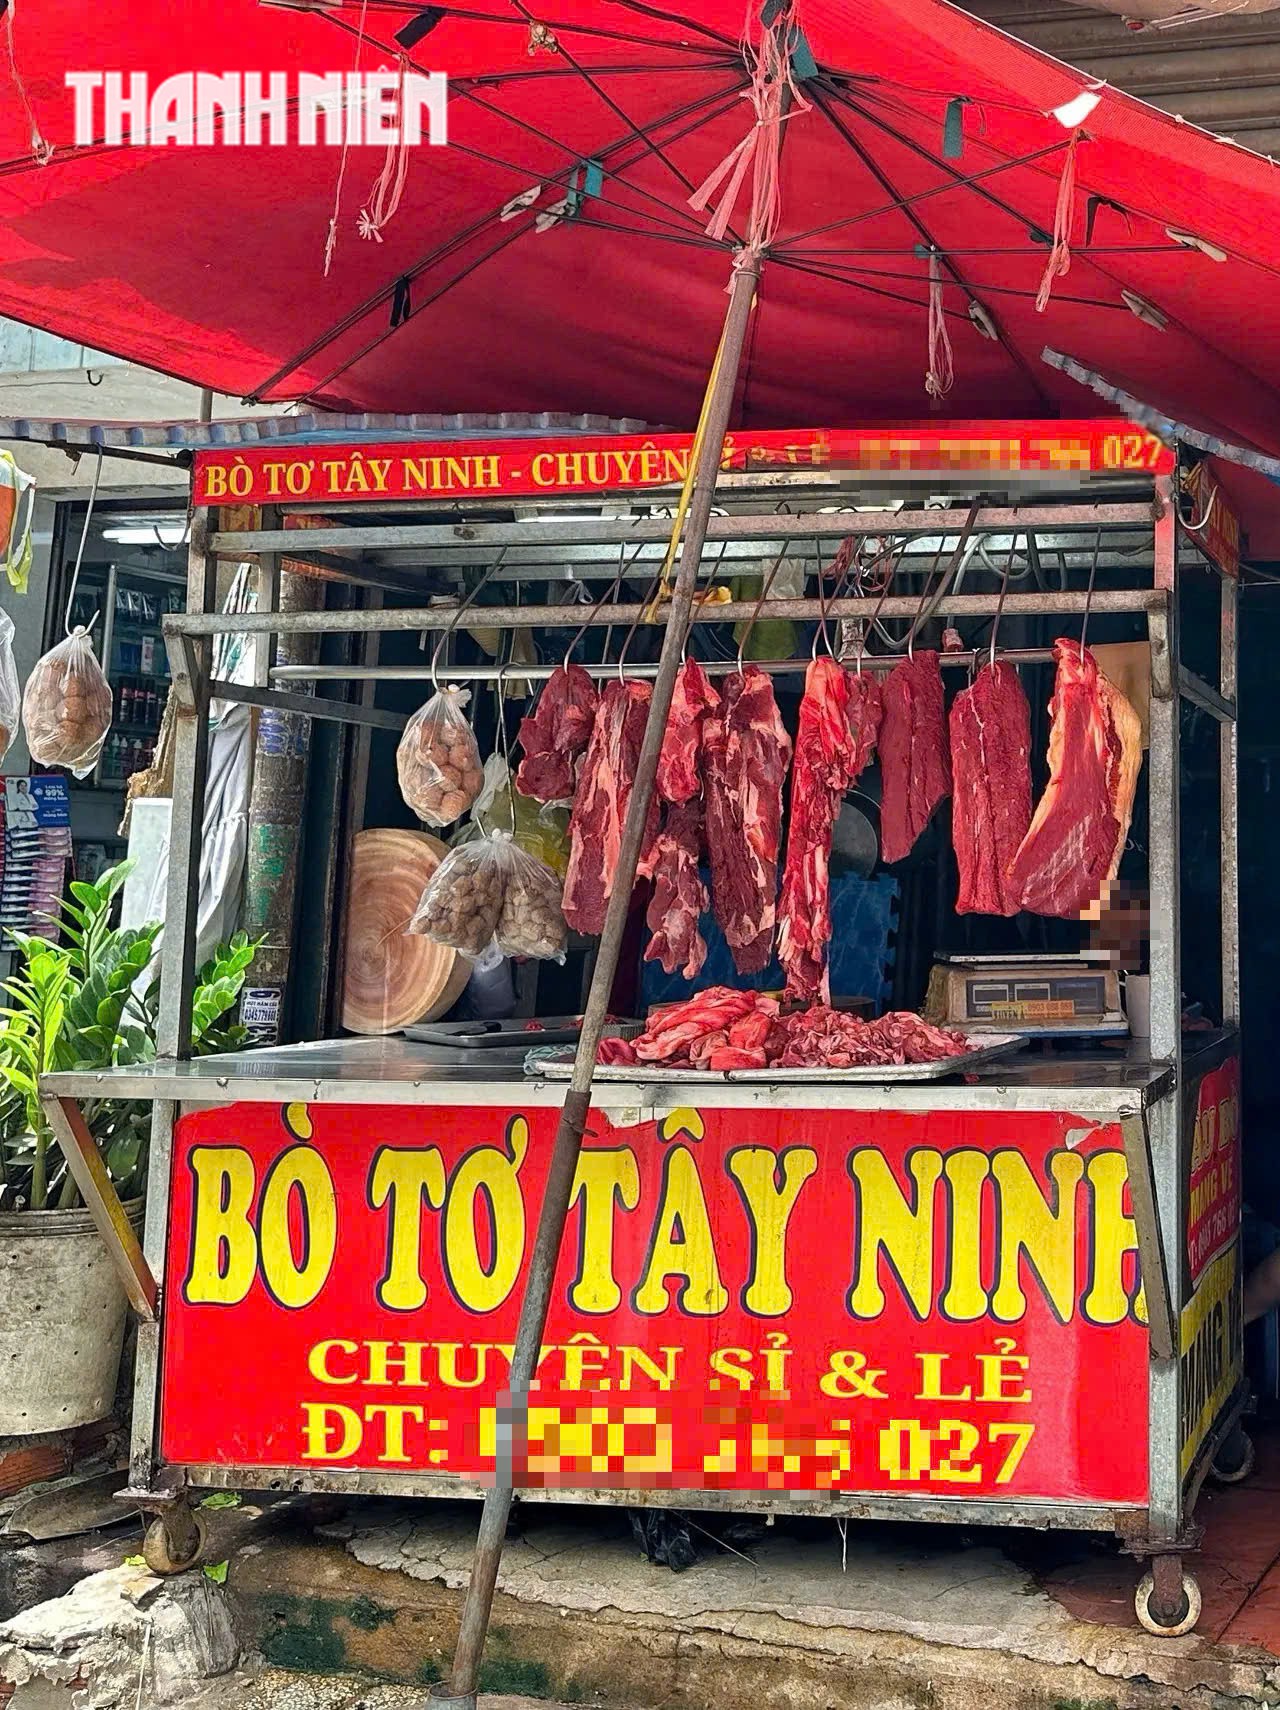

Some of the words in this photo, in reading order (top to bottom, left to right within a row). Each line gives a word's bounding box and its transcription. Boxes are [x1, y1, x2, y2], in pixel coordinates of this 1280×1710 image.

[204, 456, 254, 498] BÒ
[262, 459, 318, 496] TƠ
[323, 451, 393, 493] TÂY
[402, 454, 502, 491] NINH
[531, 441, 694, 487] CHUYÊN
[182, 1101, 338, 1311] BÒ
[368, 1113, 530, 1314] TƠ
[566, 1108, 819, 1318] TÂY
[709, 1332, 794, 1394] SỈ
[819, 1350, 889, 1399] &
[914, 1337, 1033, 1402] LẺ
[300, 1401, 447, 1464] ĐT:
[879, 1418, 1036, 1484] 027
